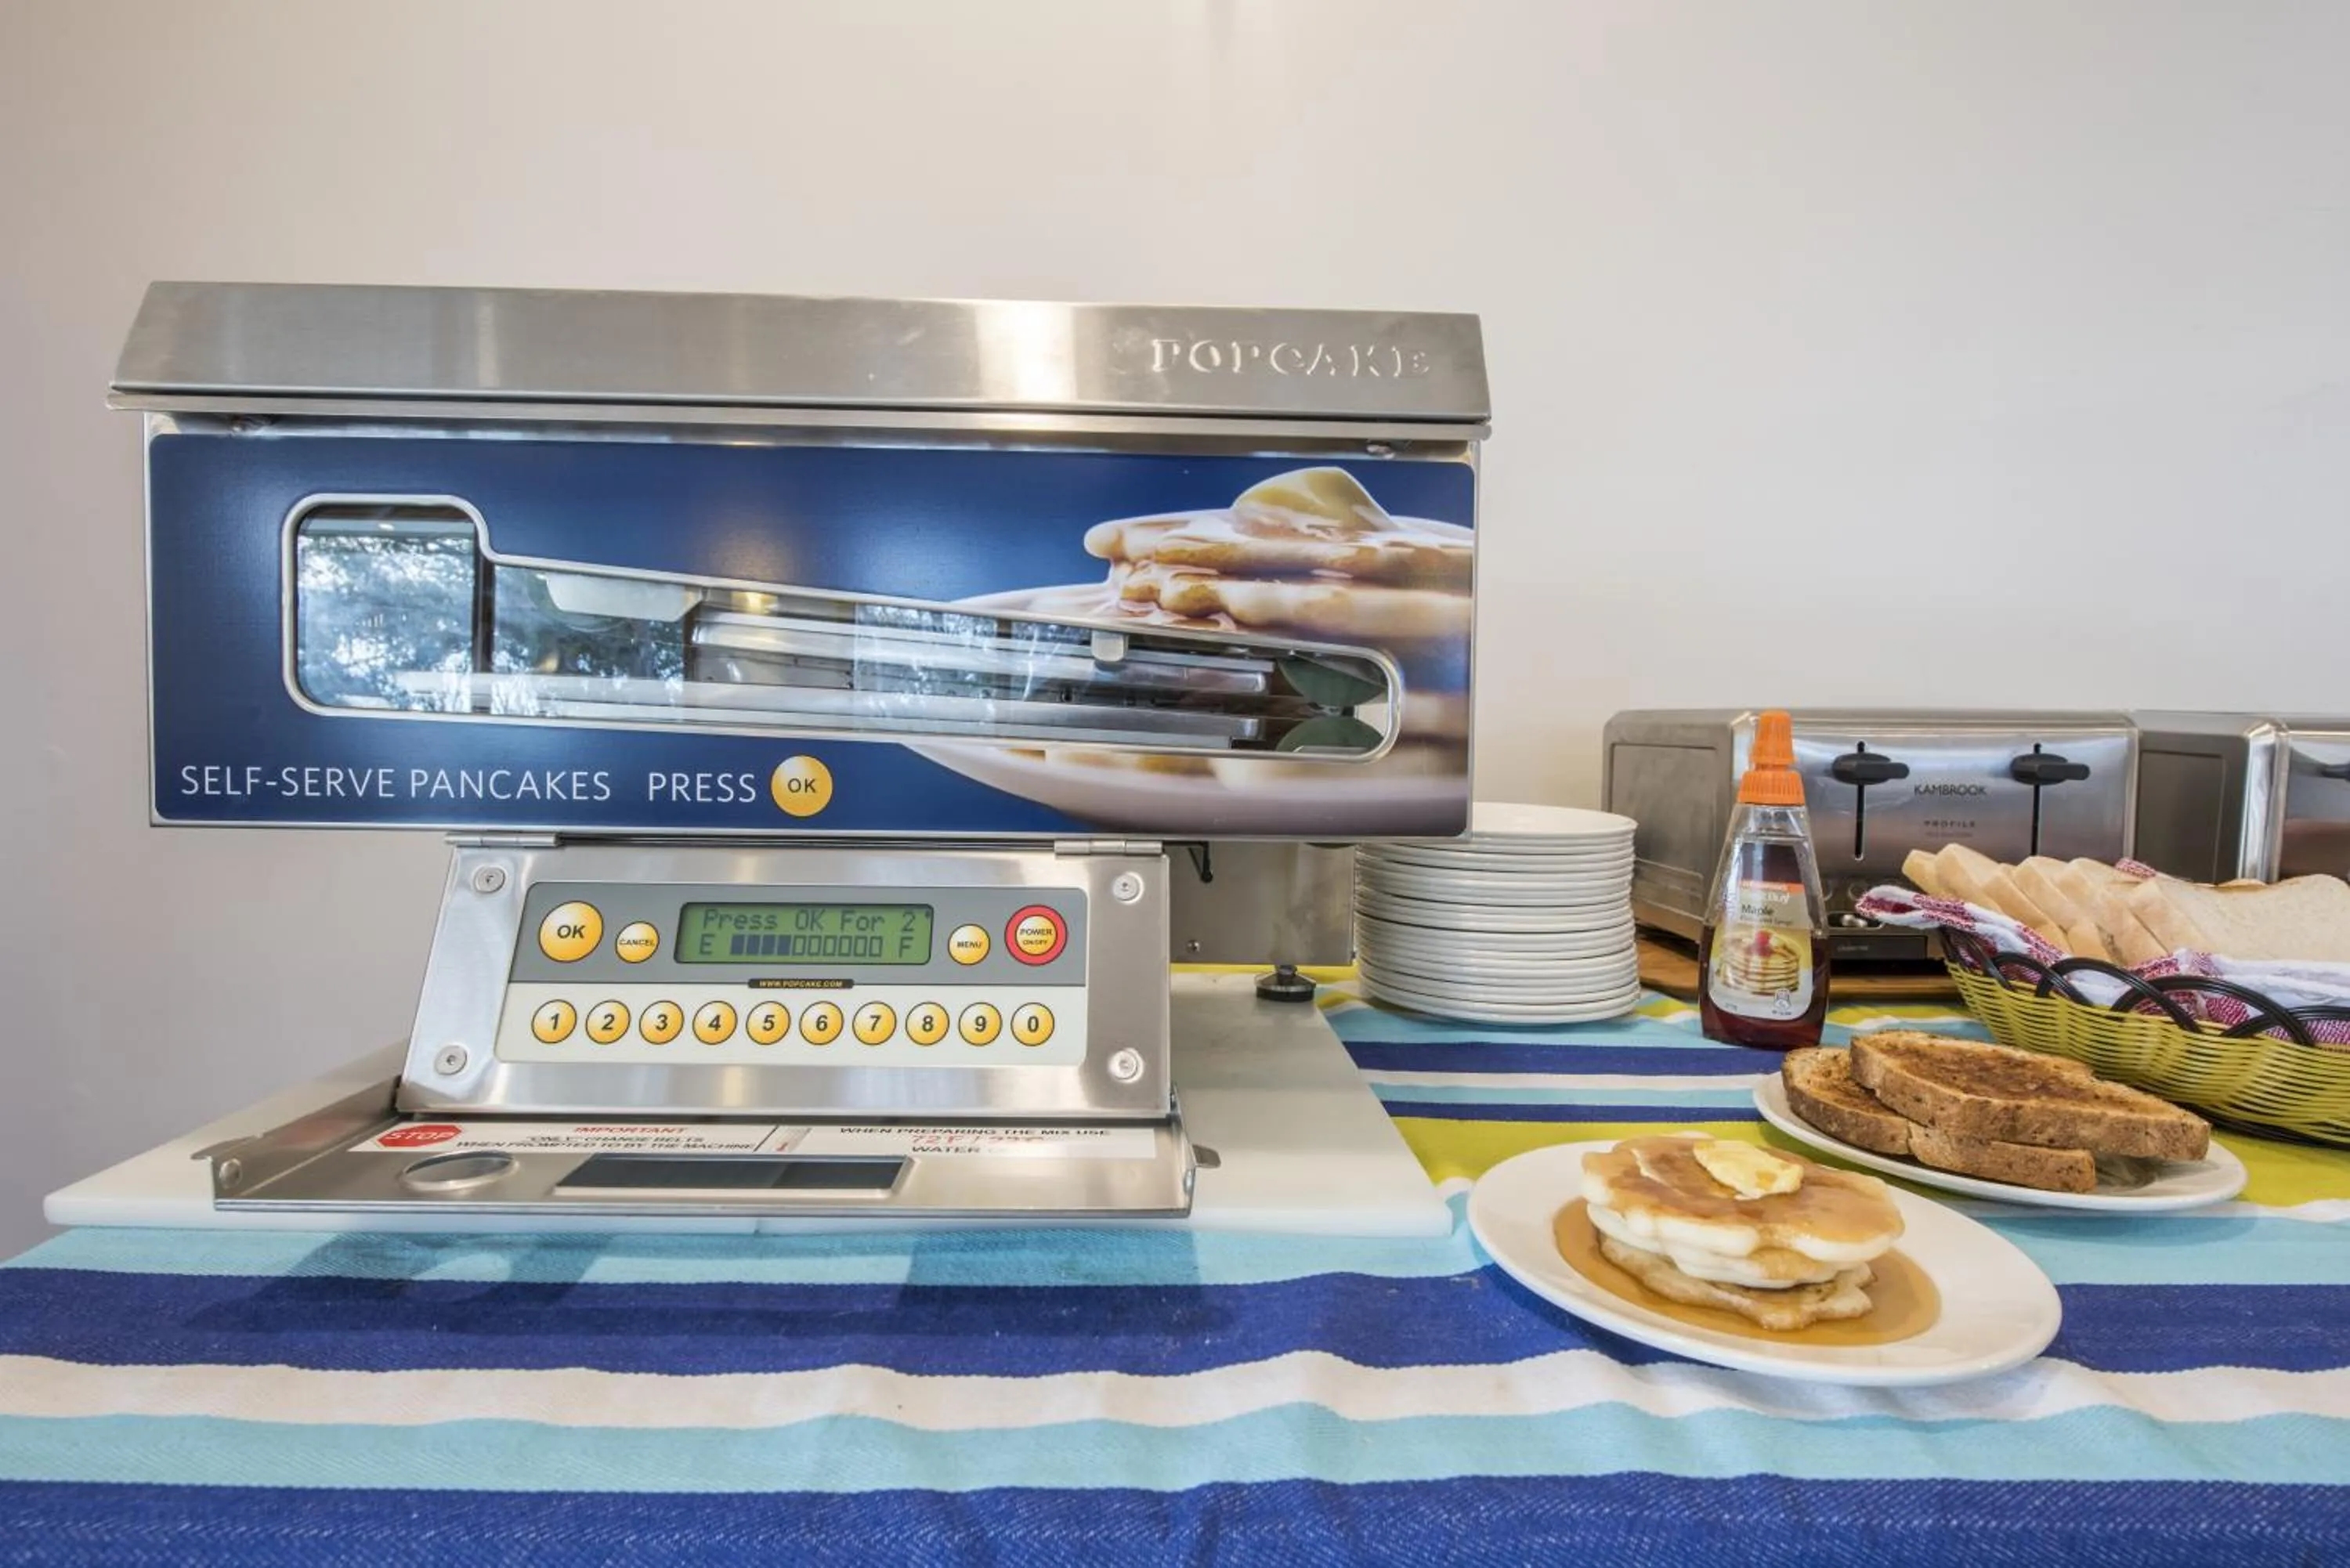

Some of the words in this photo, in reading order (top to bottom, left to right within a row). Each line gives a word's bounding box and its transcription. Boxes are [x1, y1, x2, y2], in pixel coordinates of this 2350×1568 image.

[1152, 338, 1430, 378] POPCAKE
[180, 764, 396, 798] SELF-SERVE
[410, 768, 612, 803] PANCAKES
[648, 771, 757, 804] PRESS
[786, 777, 818, 793] OK
[1914, 783, 1987, 797] KAMBROOK
[703, 908, 778, 931] Press
[794, 909, 826, 932] OK
[841, 909, 886, 932] For
[901, 911, 916, 933] 2
[556, 924, 585, 940] OK
[619, 938, 656, 947] CANCEL
[699, 933, 715, 956] E
[898, 936, 914, 958] F
[956, 941, 982, 949] MENU
[550, 1013, 560, 1031] 1
[601, 1013, 615, 1031] 2
[656, 1014, 668, 1031] 3
[707, 1014, 721, 1031] 4
[762, 1015, 776, 1031] 5
[815, 1014, 828, 1032] 6
[870, 1015, 882, 1032] 7
[921, 1015, 934, 1032] 8
[974, 1015, 987, 1033] 9
[1026, 1015, 1039, 1033] 0
